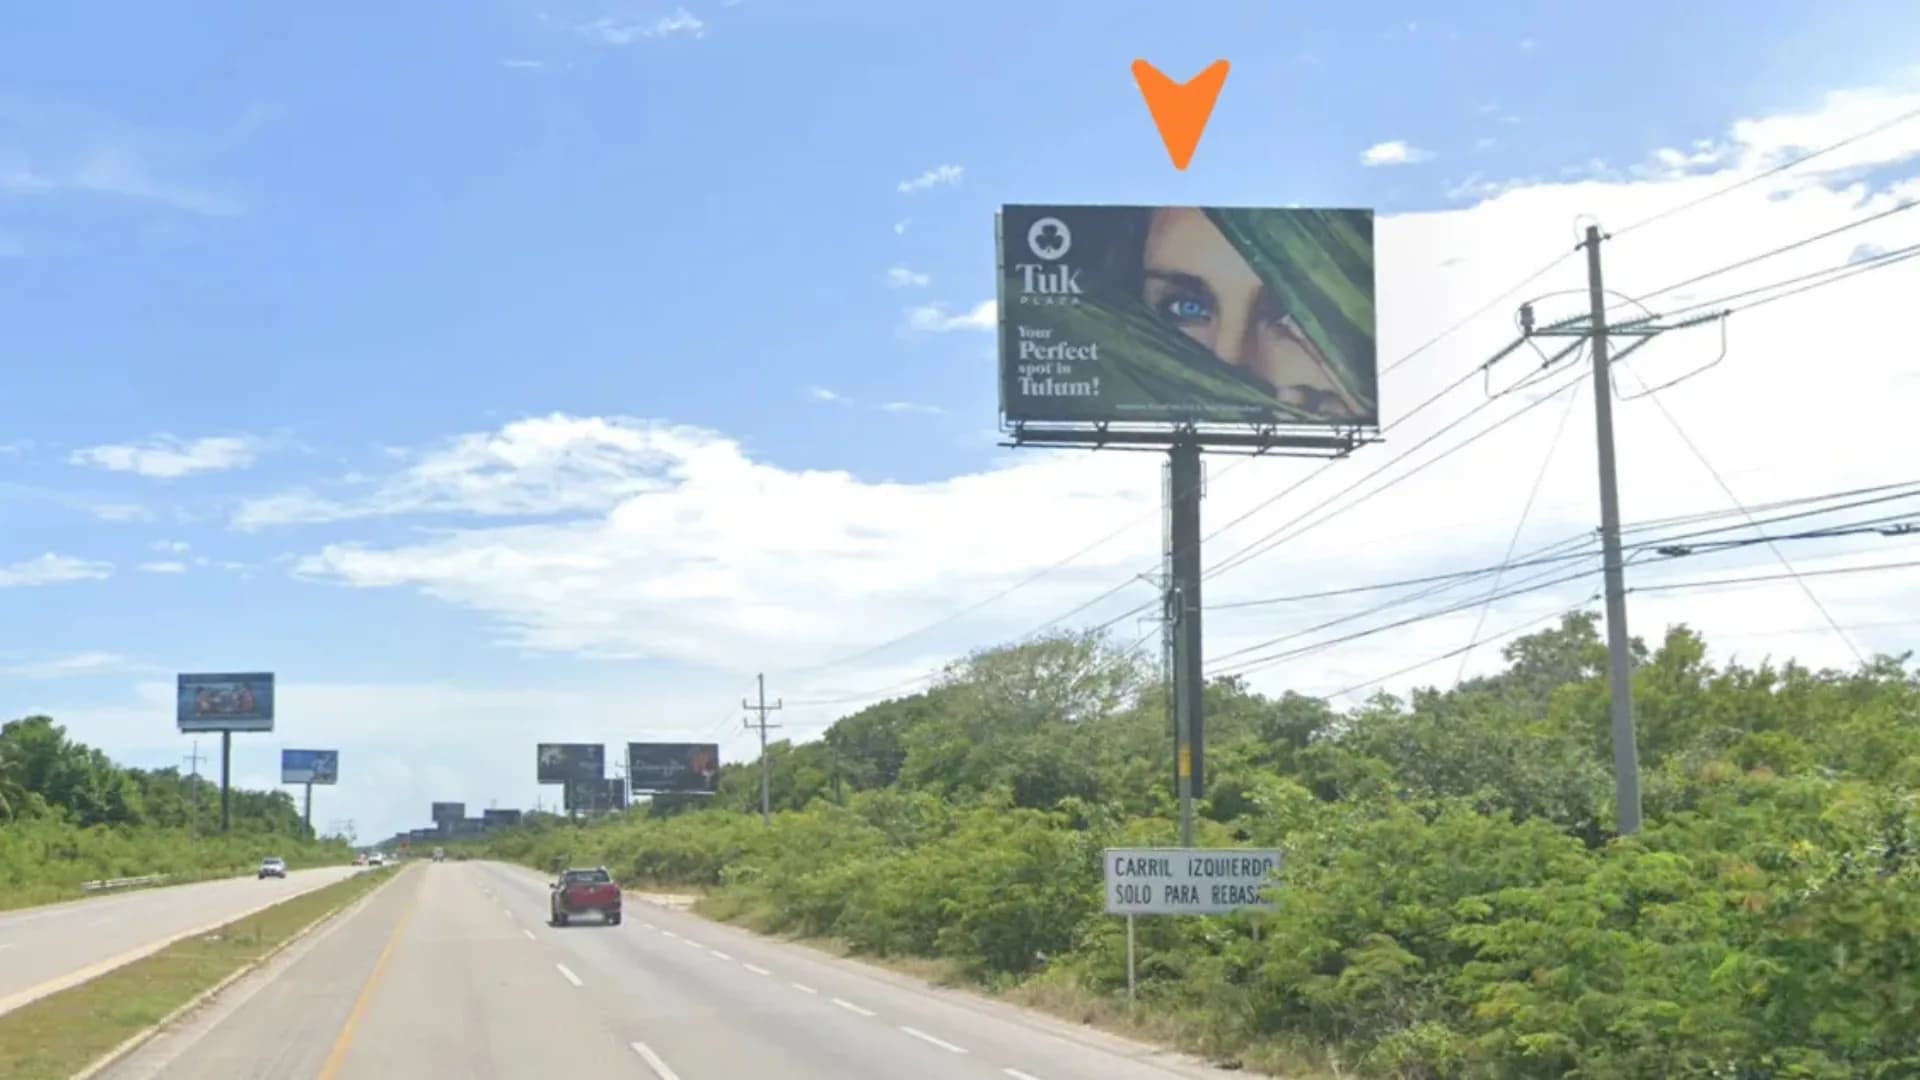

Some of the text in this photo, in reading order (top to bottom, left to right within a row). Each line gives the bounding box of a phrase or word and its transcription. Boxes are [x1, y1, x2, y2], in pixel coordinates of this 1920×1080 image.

[1015, 264, 1083, 294] Tuk
[1018, 325, 1052, 339] Your
[1019, 341, 1098, 360] Perfect
[1018, 362, 1071, 377] spot in
[1018, 376, 1099, 396] Tulum!
[1115, 857, 1173, 877] CARRIL
[1115, 884, 1151, 904] SOLO
[1164, 885, 1200, 904] PARA
